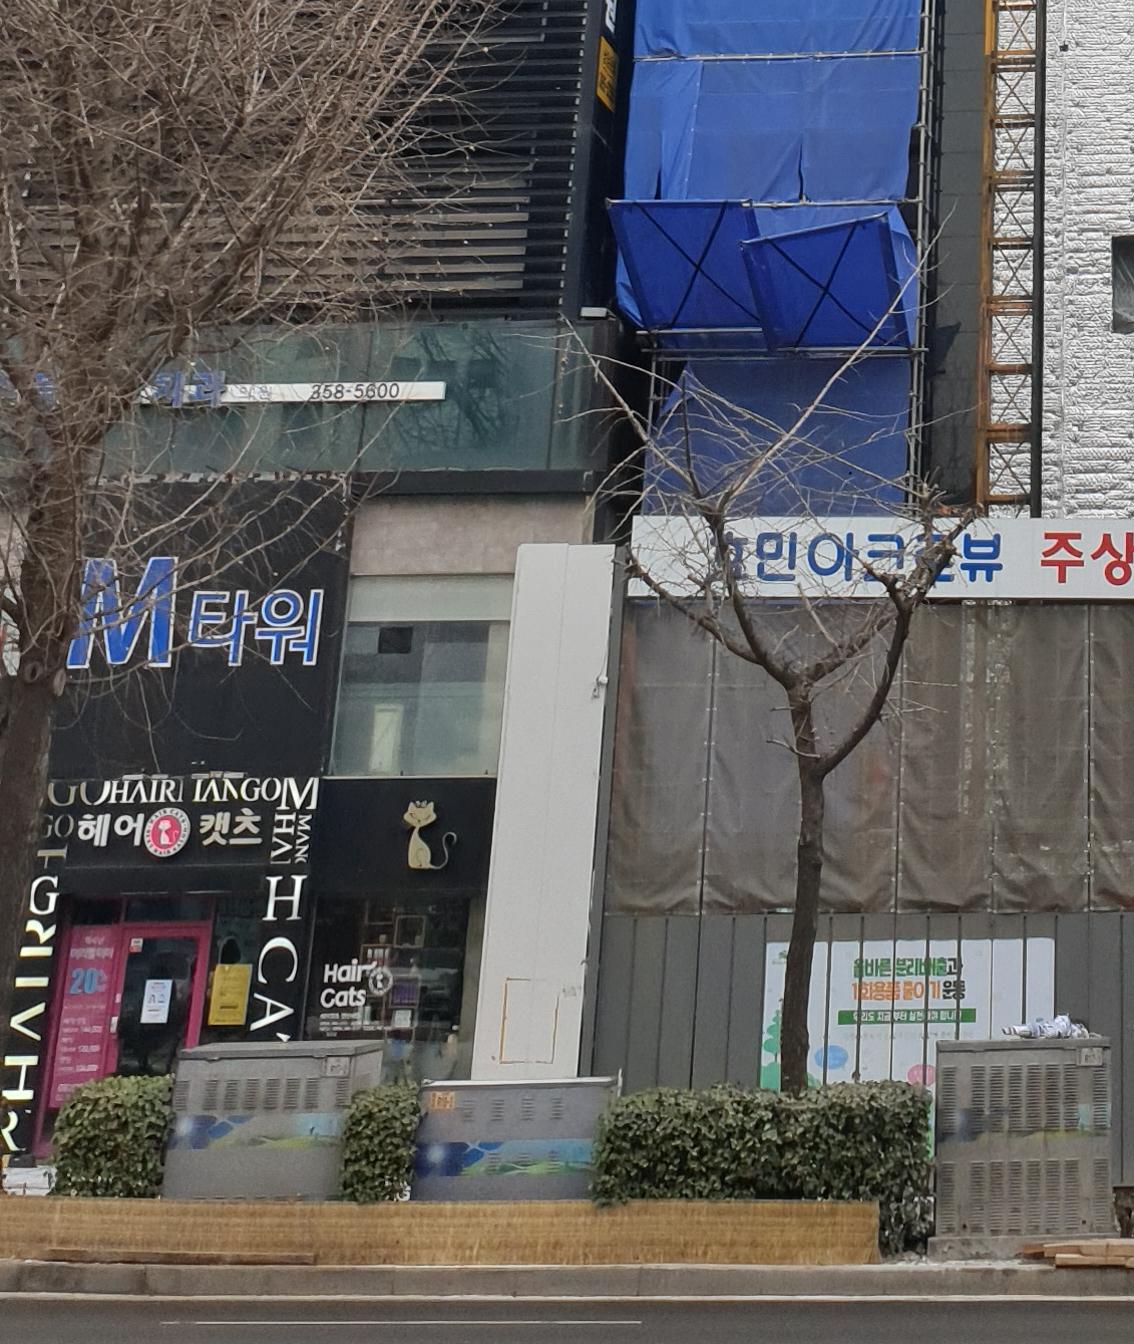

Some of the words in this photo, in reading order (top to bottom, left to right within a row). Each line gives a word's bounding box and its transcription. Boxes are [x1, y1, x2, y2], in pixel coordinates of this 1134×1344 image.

[311, 381, 401, 401] 358-5600
[77, 813, 145, 847] 헤어
[199, 808, 263, 845] 캣츠
[323, 958, 378, 984] Hair
[320, 986, 367, 1009] Cats
